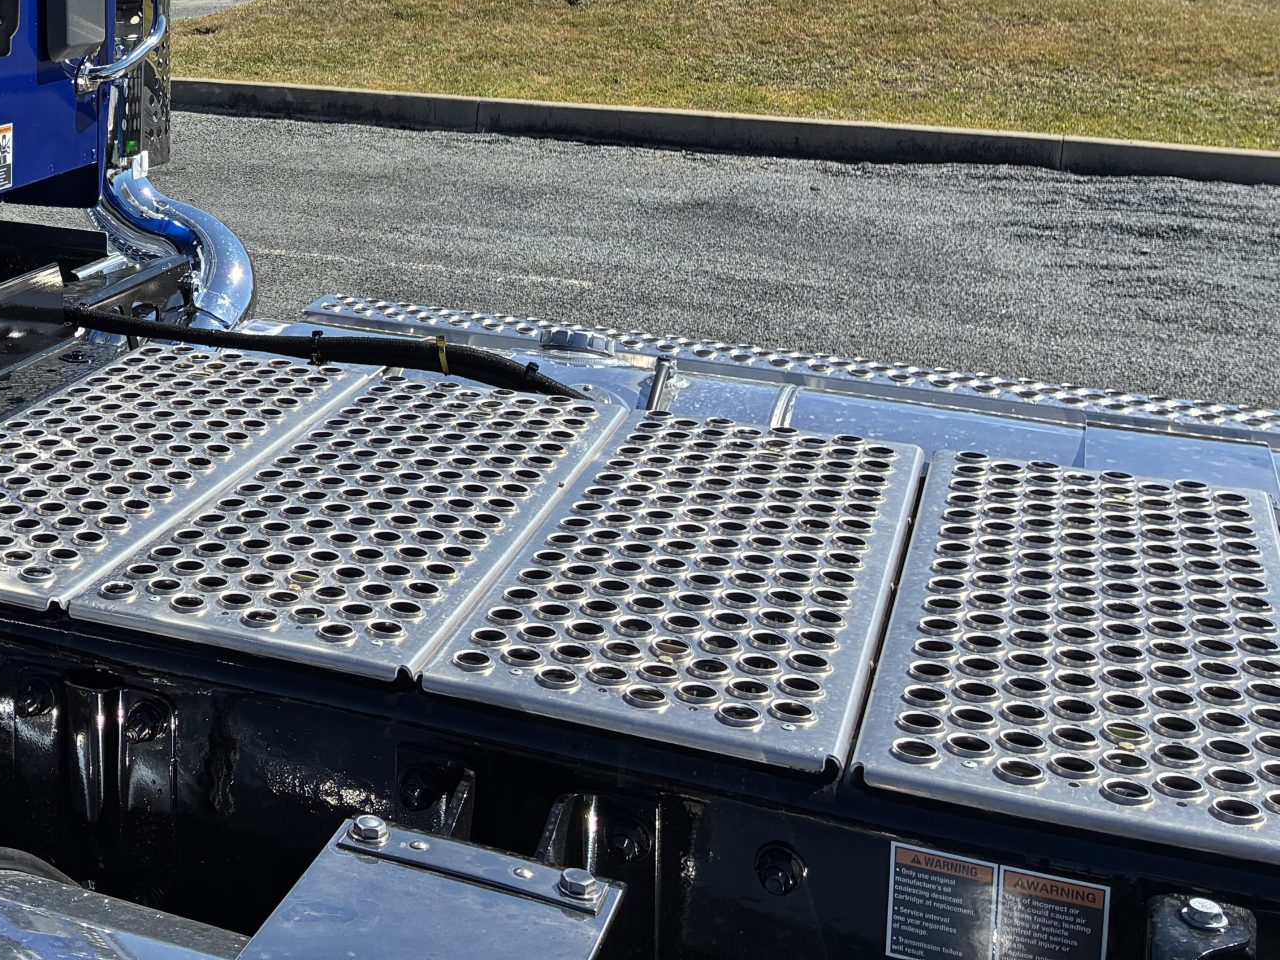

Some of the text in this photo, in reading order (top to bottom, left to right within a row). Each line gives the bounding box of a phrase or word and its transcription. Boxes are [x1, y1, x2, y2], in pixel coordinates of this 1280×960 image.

[925, 856, 977, 877] WARNING
[896, 876, 941, 891] manufacture's
[902, 868, 916, 877] Only
[931, 875, 956, 886] original
[895, 884, 963, 904] coalescing desiccant
[1027, 881, 1097, 903] WARNING
[895, 893, 923, 905] cartridge
[934, 901, 975, 916] replacement.
[1032, 900, 1067, 913] incorrect
[900, 906, 950, 923] Service interval
[1027, 907, 1048, 916] could
[1051, 912, 1074, 922] cause
[1076, 917, 1087, 925] air
[907, 918, 921, 926] year
[923, 921, 956, 934] regardless
[1042, 925, 1068, 936] vehicle
[1063, 922, 1091, 935] leading
[899, 936, 963, 957] Transmission failure
[1033, 932, 1047, 940] and
[1050, 935, 1078, 946] serious
[1039, 941, 1059, 951] injury
